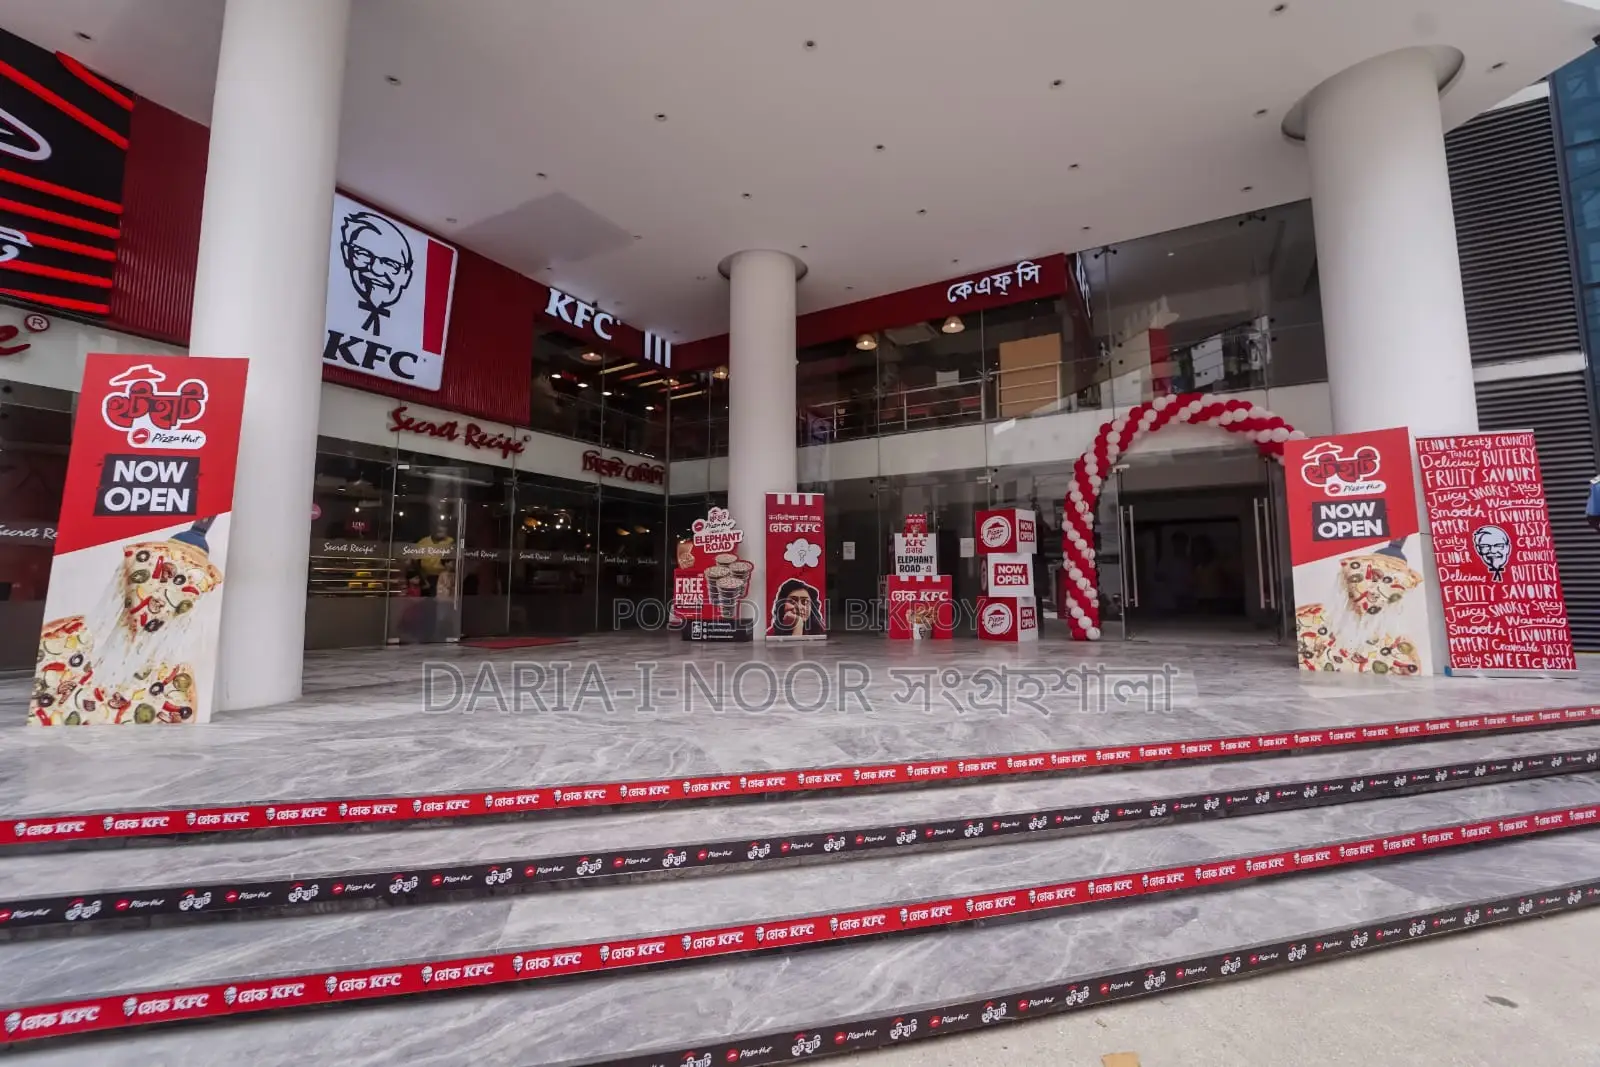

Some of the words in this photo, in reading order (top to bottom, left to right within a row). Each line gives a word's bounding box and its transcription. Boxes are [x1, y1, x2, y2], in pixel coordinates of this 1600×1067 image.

[545, 287, 613, 341] KFC
[323, 329, 418, 380] KFC
[390, 406, 459, 441] Secret
[151, 433, 180, 443] Pizza
[181, 434, 201, 443] Hut
[1416, 439, 1458, 452] TENDER
[1461, 438, 1493, 449] Zesty
[1495, 434, 1534, 447] CRUNCHY
[1420, 454, 1481, 469] Delicious
[1481, 447, 1536, 467] BUTTERY
[113, 460, 188, 483] NOW
[1425, 468, 1476, 488] FRUITY
[1481, 466, 1537, 483] SAVOURY
[1343, 484, 1365, 493] Pizza
[1427, 490, 1471, 508] Juicy
[1469, 484, 1510, 500] SMOKEY
[1510, 482, 1541, 497] Spicy
[104, 486, 190, 512] OPEN
[1485, 495, 1545, 508] Warming
[1320, 502, 1376, 519] NOW
[1431, 504, 1487, 520] Smooth
[1487, 509, 1547, 524] FLAVOURFUL
[794, 523, 821, 533] KFC
[1020, 521, 1032, 530] NOW
[1318, 519, 1383, 538] OPEN
[1431, 519, 1470, 535] PEPPERY
[1512, 521, 1549, 537] TASTY
[323, 542, 349, 552] Secret
[695, 532, 741, 545] ELEPHANT
[705, 542, 732, 552] ROAD
[905, 539, 927, 547] KFC
[402, 546, 426, 556] Secret
[897, 555, 934, 564] ELEPHANT
[1434, 551, 1473, 564] TENDER
[1516, 549, 1555, 563] CRUNCHY
[998, 565, 1023, 574] NOW
[1438, 567, 1487, 583] Delicious
[1511, 563, 1558, 583] BUTTERY
[675, 577, 704, 594] FREE
[996, 574, 1026, 585] OPEN
[675, 593, 704, 605] PIZZAS
[919, 591, 949, 602] KFC
[1443, 584, 1497, 603] FRUITY
[1501, 583, 1558, 600] SAVOURY
[1446, 606, 1490, 624] Juicy
[1488, 601, 1530, 618] SMOKEY
[1531, 600, 1563, 617] Spicy
[1505, 615, 1567, 628] Warming
[1449, 621, 1507, 636] Smooth
[1507, 628, 1569, 642] FLAVOURFUL
[1449, 637, 1489, 653] PEPPERY
[1541, 643, 1571, 656] TASTY
[1483, 653, 1531, 668] SWEET
[56, 821, 86, 833] KFC
[140, 816, 170, 828] KFC
[222, 812, 250, 823] KFC
[300, 807, 327, 818] KFC
[372, 803, 398, 815] KFC
[445, 800, 470, 810] KFC
[516, 794, 540, 805] KFC
[583, 789, 607, 800] KFC
[58, 1006, 100, 1026] KFC
[172, 993, 209, 1010] KFC
[270, 983, 305, 999] KFC
[369, 973, 402, 989] KFC
[463, 963, 495, 978] KFC
[552, 952, 583, 967] KFC
[637, 942, 665, 957] KFC
[717, 932, 745, 947] KFC
[789, 924, 815, 938] KFC
[861, 914, 886, 928] KFC
[930, 905, 953, 918] KFC
